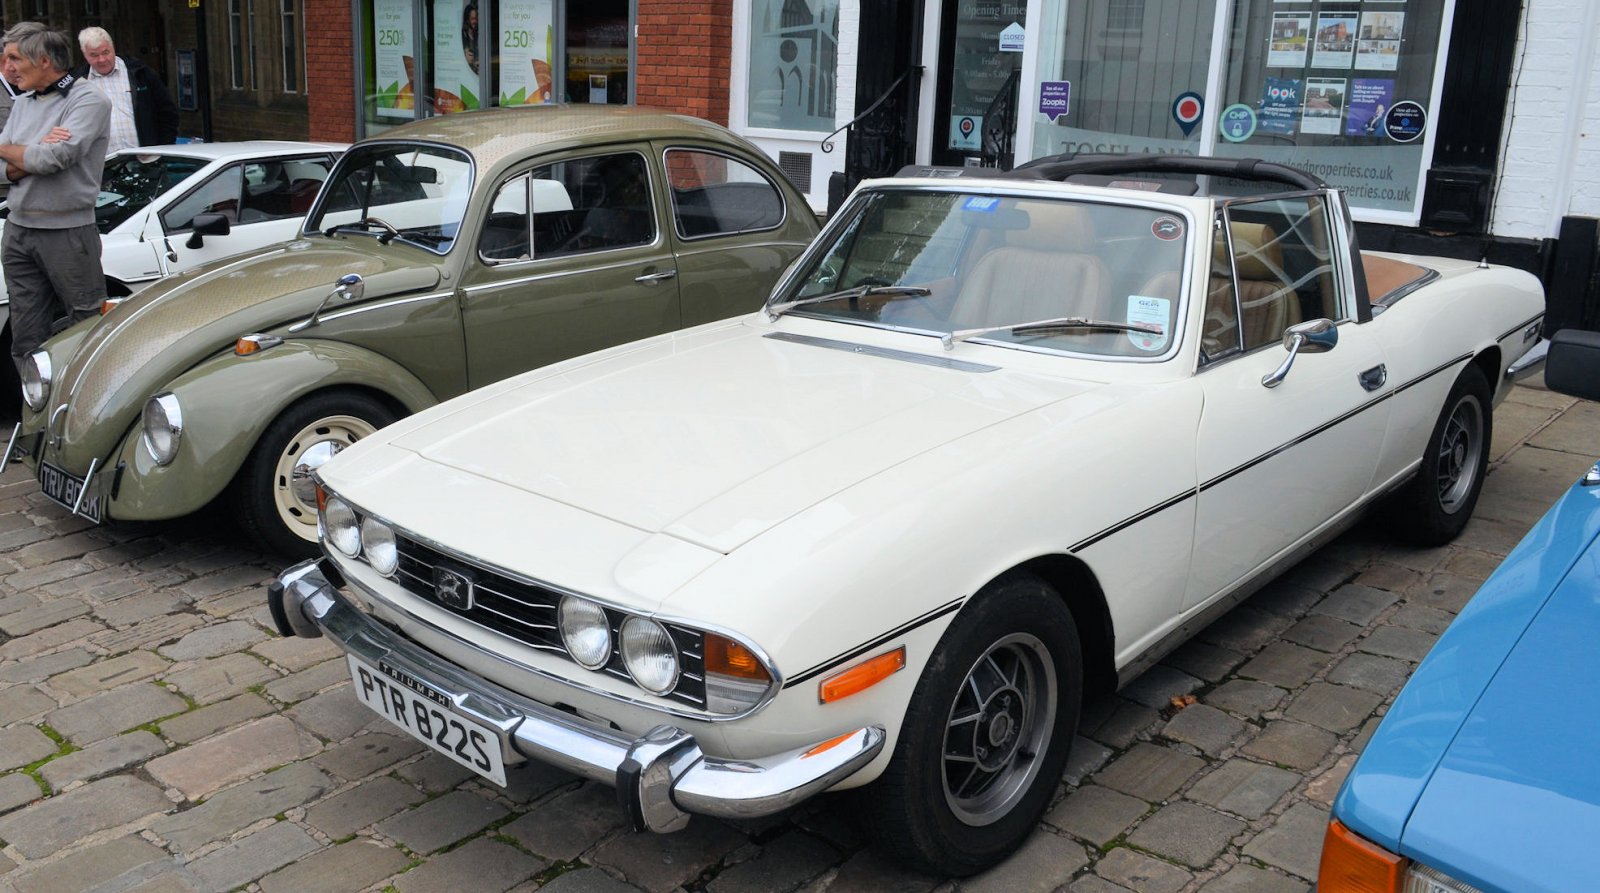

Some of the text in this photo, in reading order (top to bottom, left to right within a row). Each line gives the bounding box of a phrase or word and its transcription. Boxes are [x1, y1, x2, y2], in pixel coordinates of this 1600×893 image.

[963, 4, 1000, 19] Opening
[1267, 86, 1295, 100] look
[1042, 98, 1066, 107] Zoopla
[1229, 111, 1248, 119] CMP
[43, 466, 65, 499] TRV
[382, 664, 446, 705] TRIUMPH
[357, 665, 492, 773] PTR 822S
